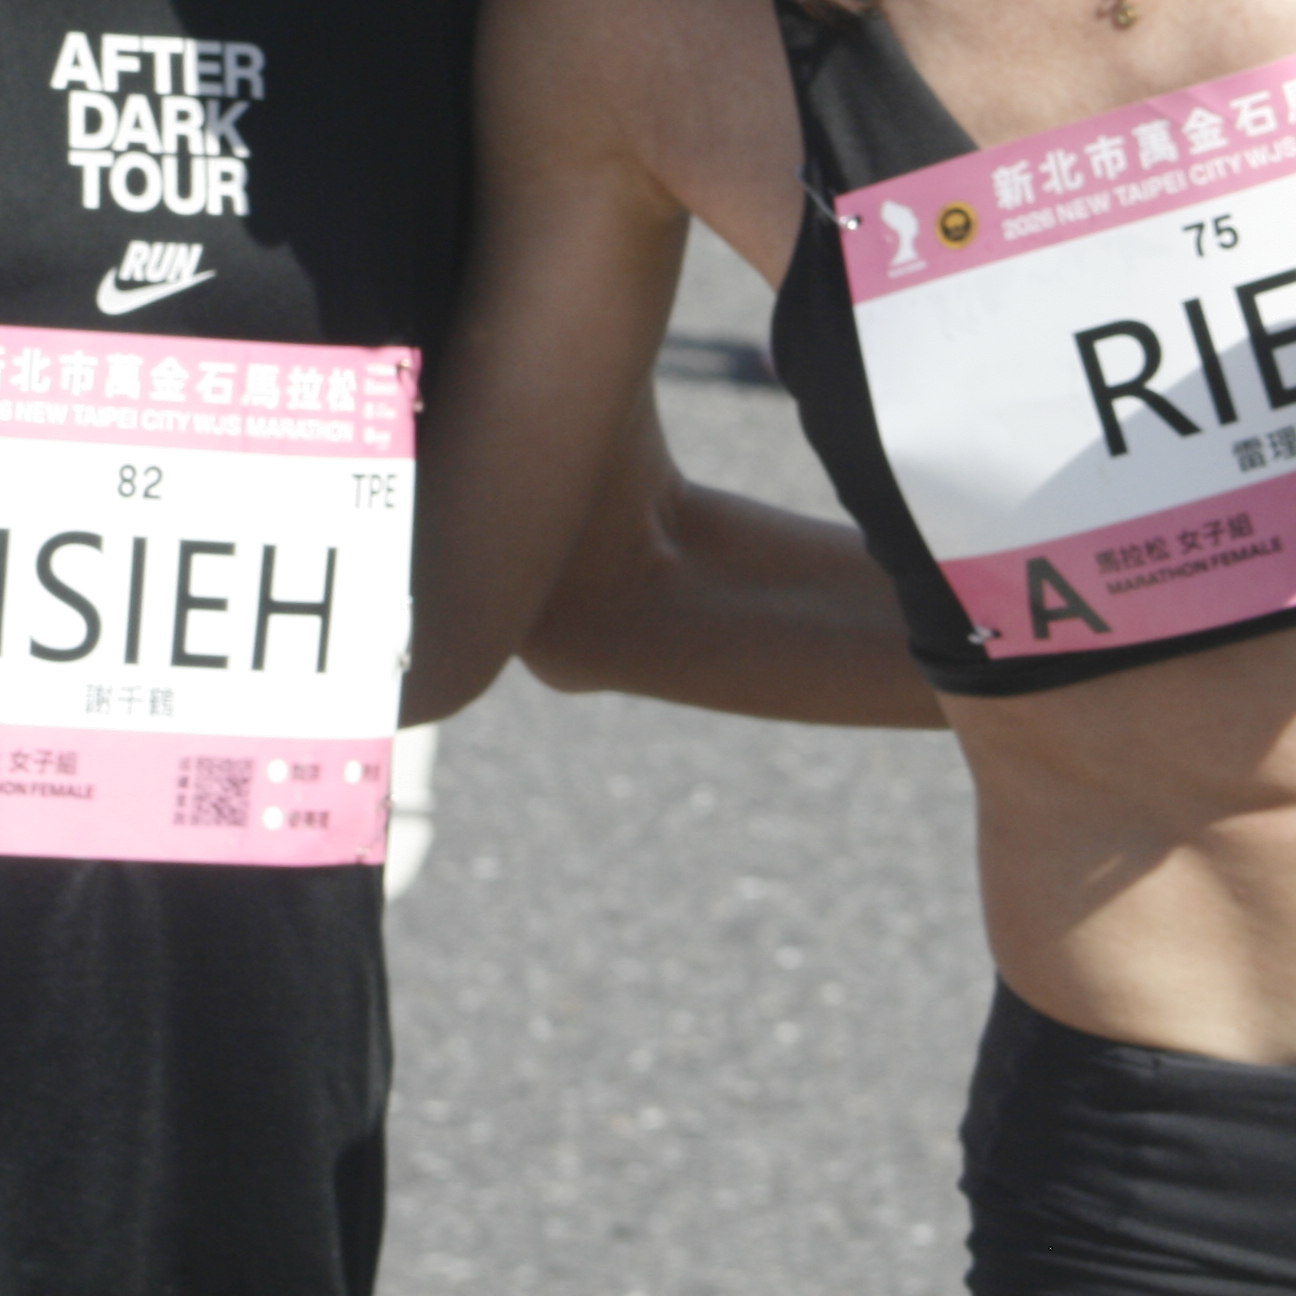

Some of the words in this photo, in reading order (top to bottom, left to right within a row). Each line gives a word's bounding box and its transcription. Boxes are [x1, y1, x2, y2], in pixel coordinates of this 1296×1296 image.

[50, 31, 266, 100] AFTER
[67, 90, 251, 158] DARK
[67, 150, 250, 216] TOUR
[1055, 191, 1111, 225] NEW
[1112, 169, 1188, 207] TAIPEI
[1189, 154, 1242, 186] CITY
[119, 240, 203, 283] RUN
[1183, 214, 1240, 258] 75
[14, 401, 68, 425] NEW
[72, 404, 139, 430] TAIPEI
[141, 408, 192, 432] CITY
[194, 412, 242, 437] WJS
[245, 415, 354, 442] MARATHON
[118, 464, 164, 500] 82
[352, 473, 396, 509] TPE
[1106, 560, 1207, 595] MARATHON
[1211, 535, 1283, 570] FEMALE
[1026, 556, 1112, 639] A
[30, 780, 95, 800] FEMALE
